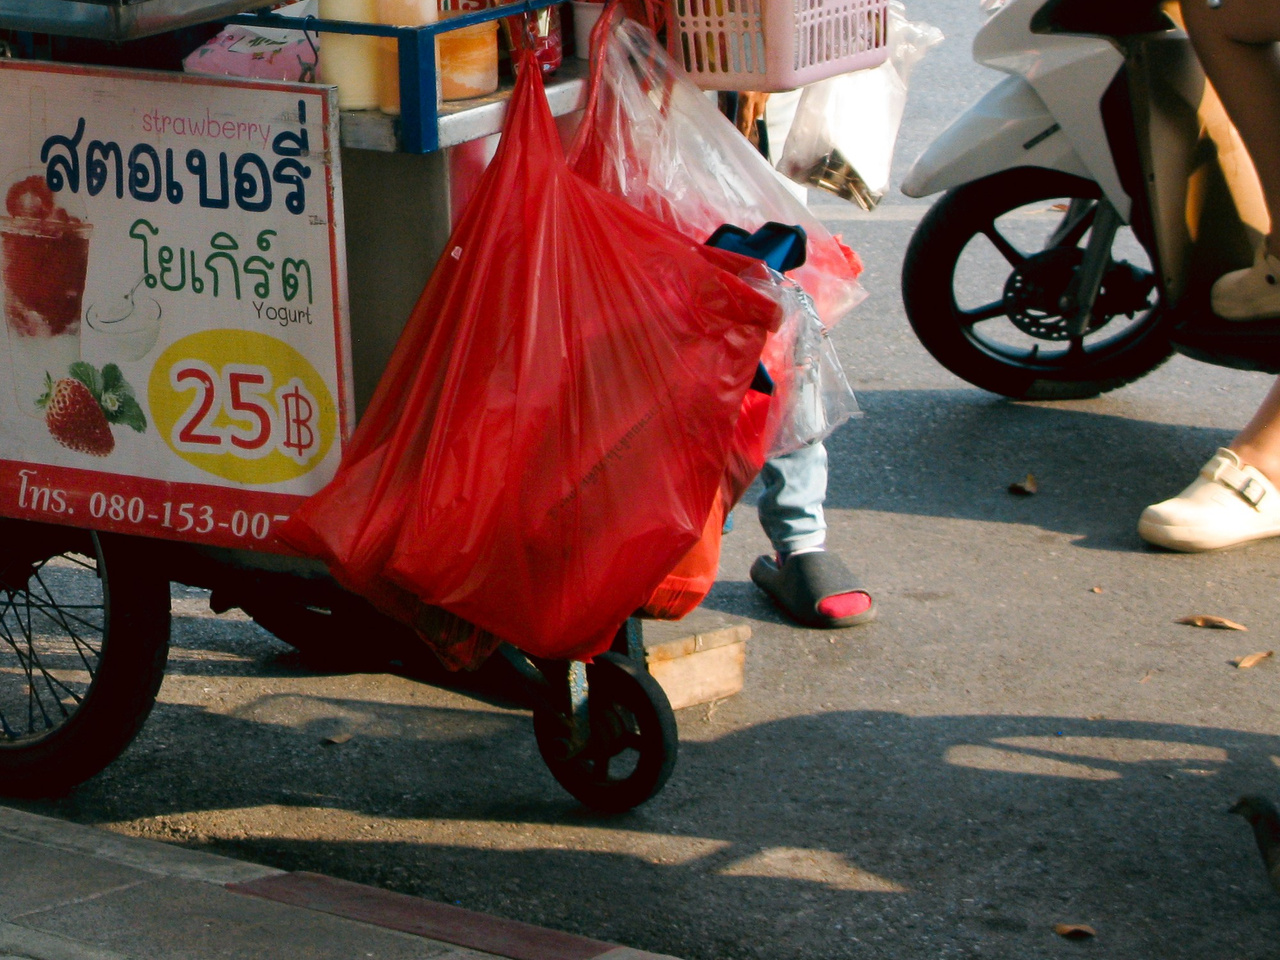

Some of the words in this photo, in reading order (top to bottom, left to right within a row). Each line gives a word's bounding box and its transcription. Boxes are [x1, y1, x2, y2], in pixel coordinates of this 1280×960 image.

[40, 99, 312, 216] สตอเบอรี่
[142, 108, 271, 149] strawberry
[128, 218, 314, 305] โยเกิร์ต
[252, 301, 313, 327] Yogurt
[18, 469, 74, 514] โทร.
[89, 492, 290, 540] 080-153-00
